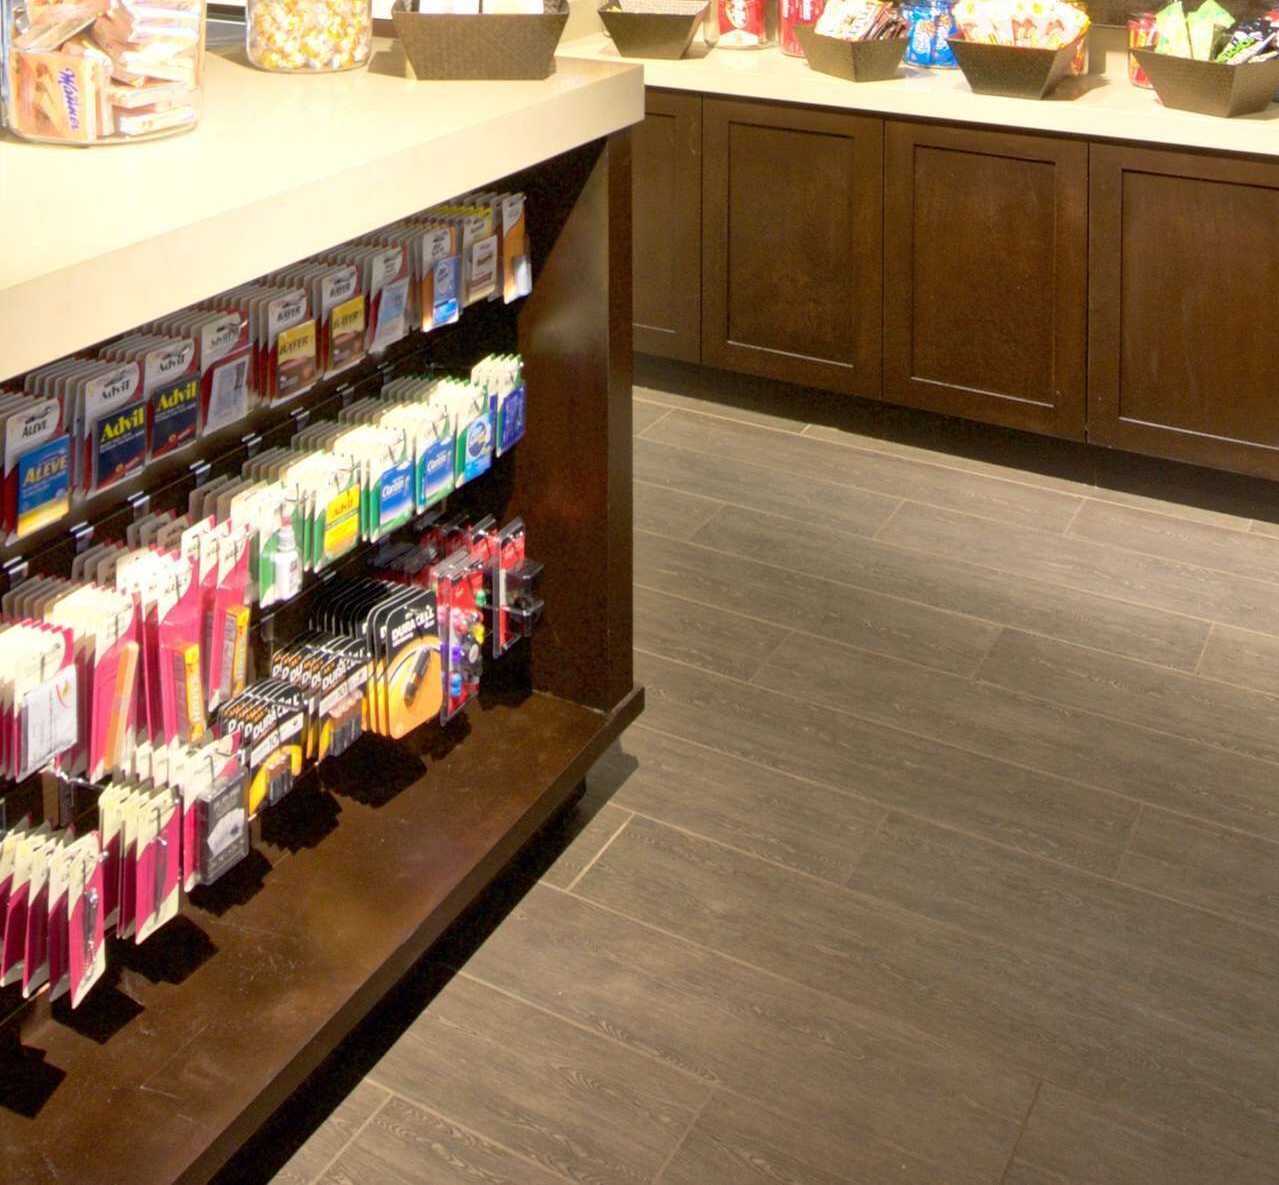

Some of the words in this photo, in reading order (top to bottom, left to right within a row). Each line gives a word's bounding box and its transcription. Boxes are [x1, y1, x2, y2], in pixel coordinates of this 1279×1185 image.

[101, 380, 131, 401] Advil
[157, 380, 197, 412] Advil
[22, 419, 48, 438] ALEVE
[100, 405, 145, 444] Advil
[23, 456, 68, 485] ALEVE
